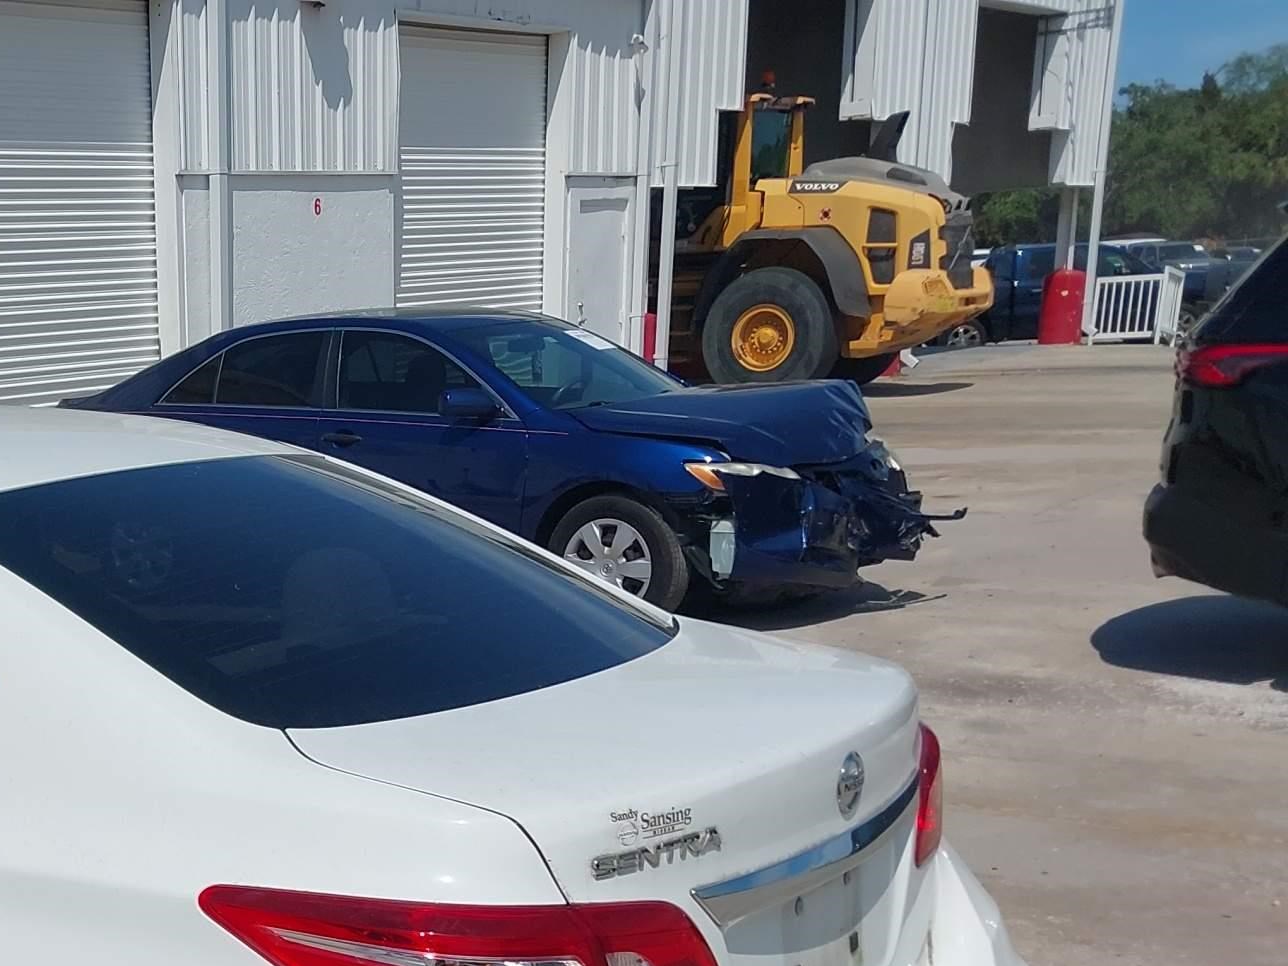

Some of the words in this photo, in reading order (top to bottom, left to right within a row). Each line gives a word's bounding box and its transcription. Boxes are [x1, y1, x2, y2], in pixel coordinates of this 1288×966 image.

[795, 183, 839, 191] VOLVO
[314, 198, 322, 216] 6
[610, 808, 639, 822] Sandy
[640, 806, 692, 830] Sansing
[592, 825, 722, 881] SENTRA
